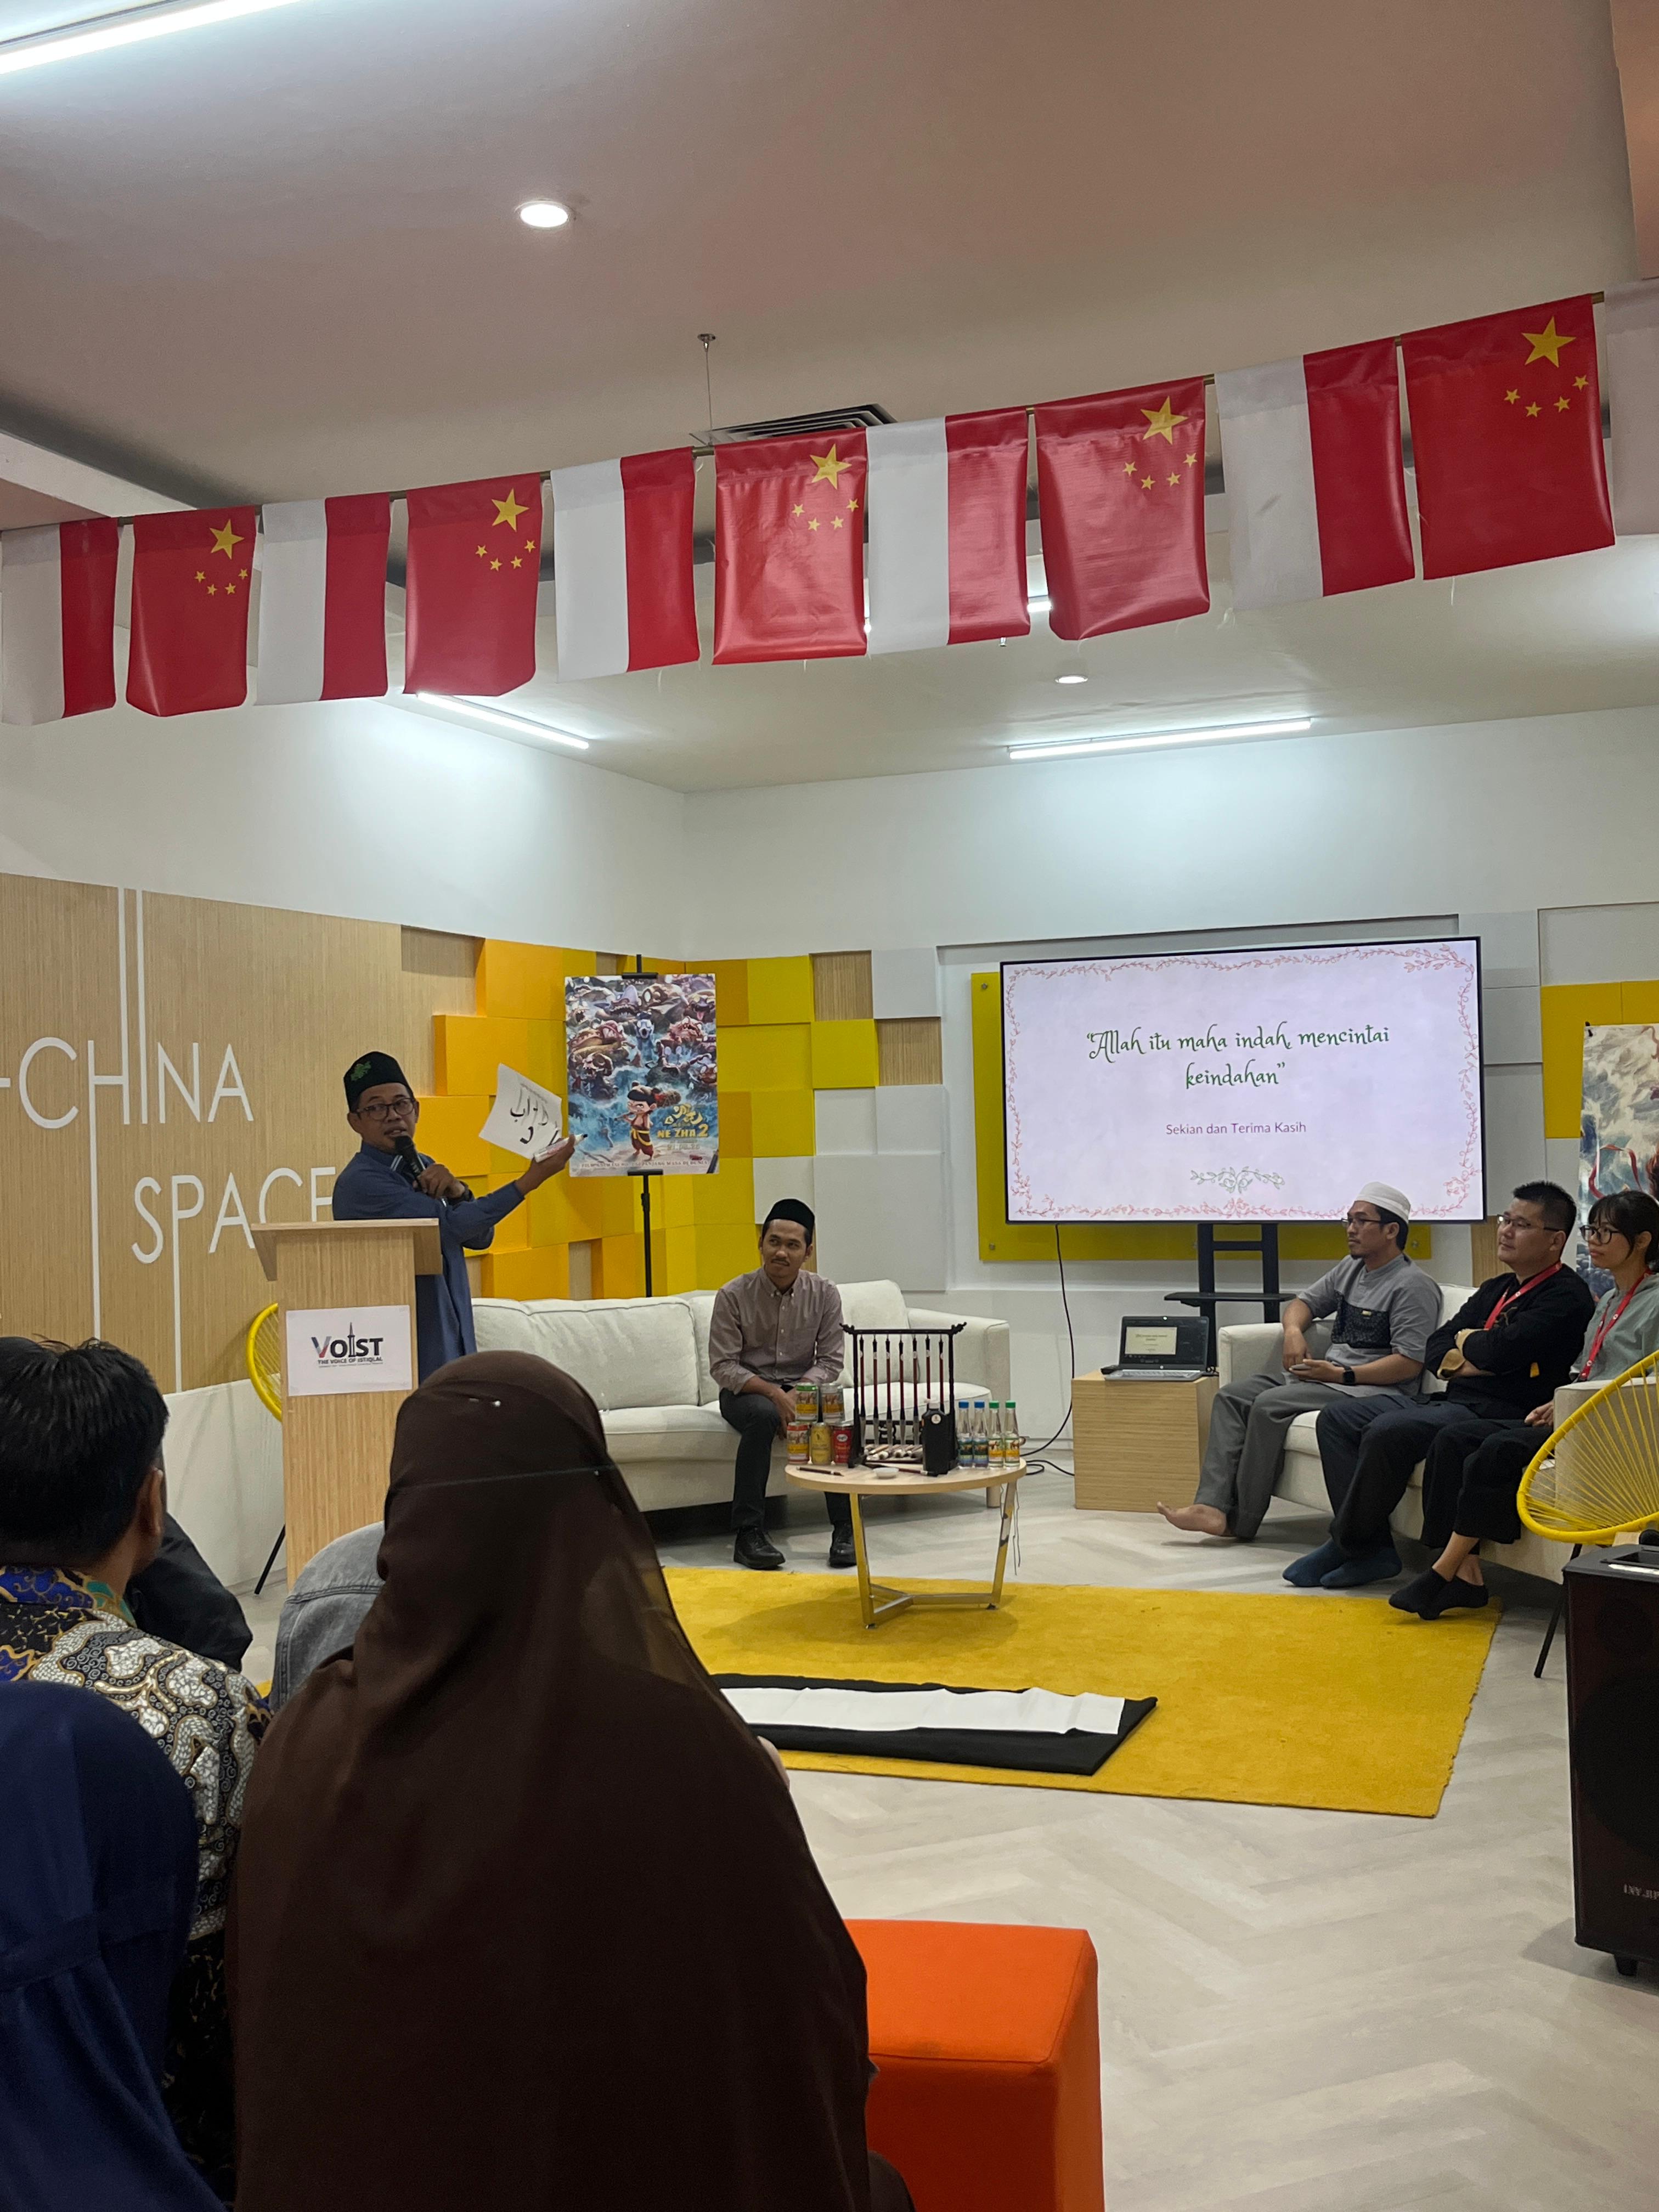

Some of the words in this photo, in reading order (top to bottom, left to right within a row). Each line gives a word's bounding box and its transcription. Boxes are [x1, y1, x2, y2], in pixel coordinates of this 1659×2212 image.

[1149, 1032, 1171, 1051] itu
[1177, 1024, 1227, 1052] maha
[1298, 1024, 1389, 1047] mencintai
[658, 1130, 671, 1138] NE
[675, 1128, 696, 1138] ZHA
[698, 1124, 708, 1138] 2
[1166, 1124, 1203, 1135] Sekian
[1206, 1124, 1227, 1134] dan
[1231, 1122, 1271, 1133] Terima
[1274, 1121, 1306, 1133] Kasih
